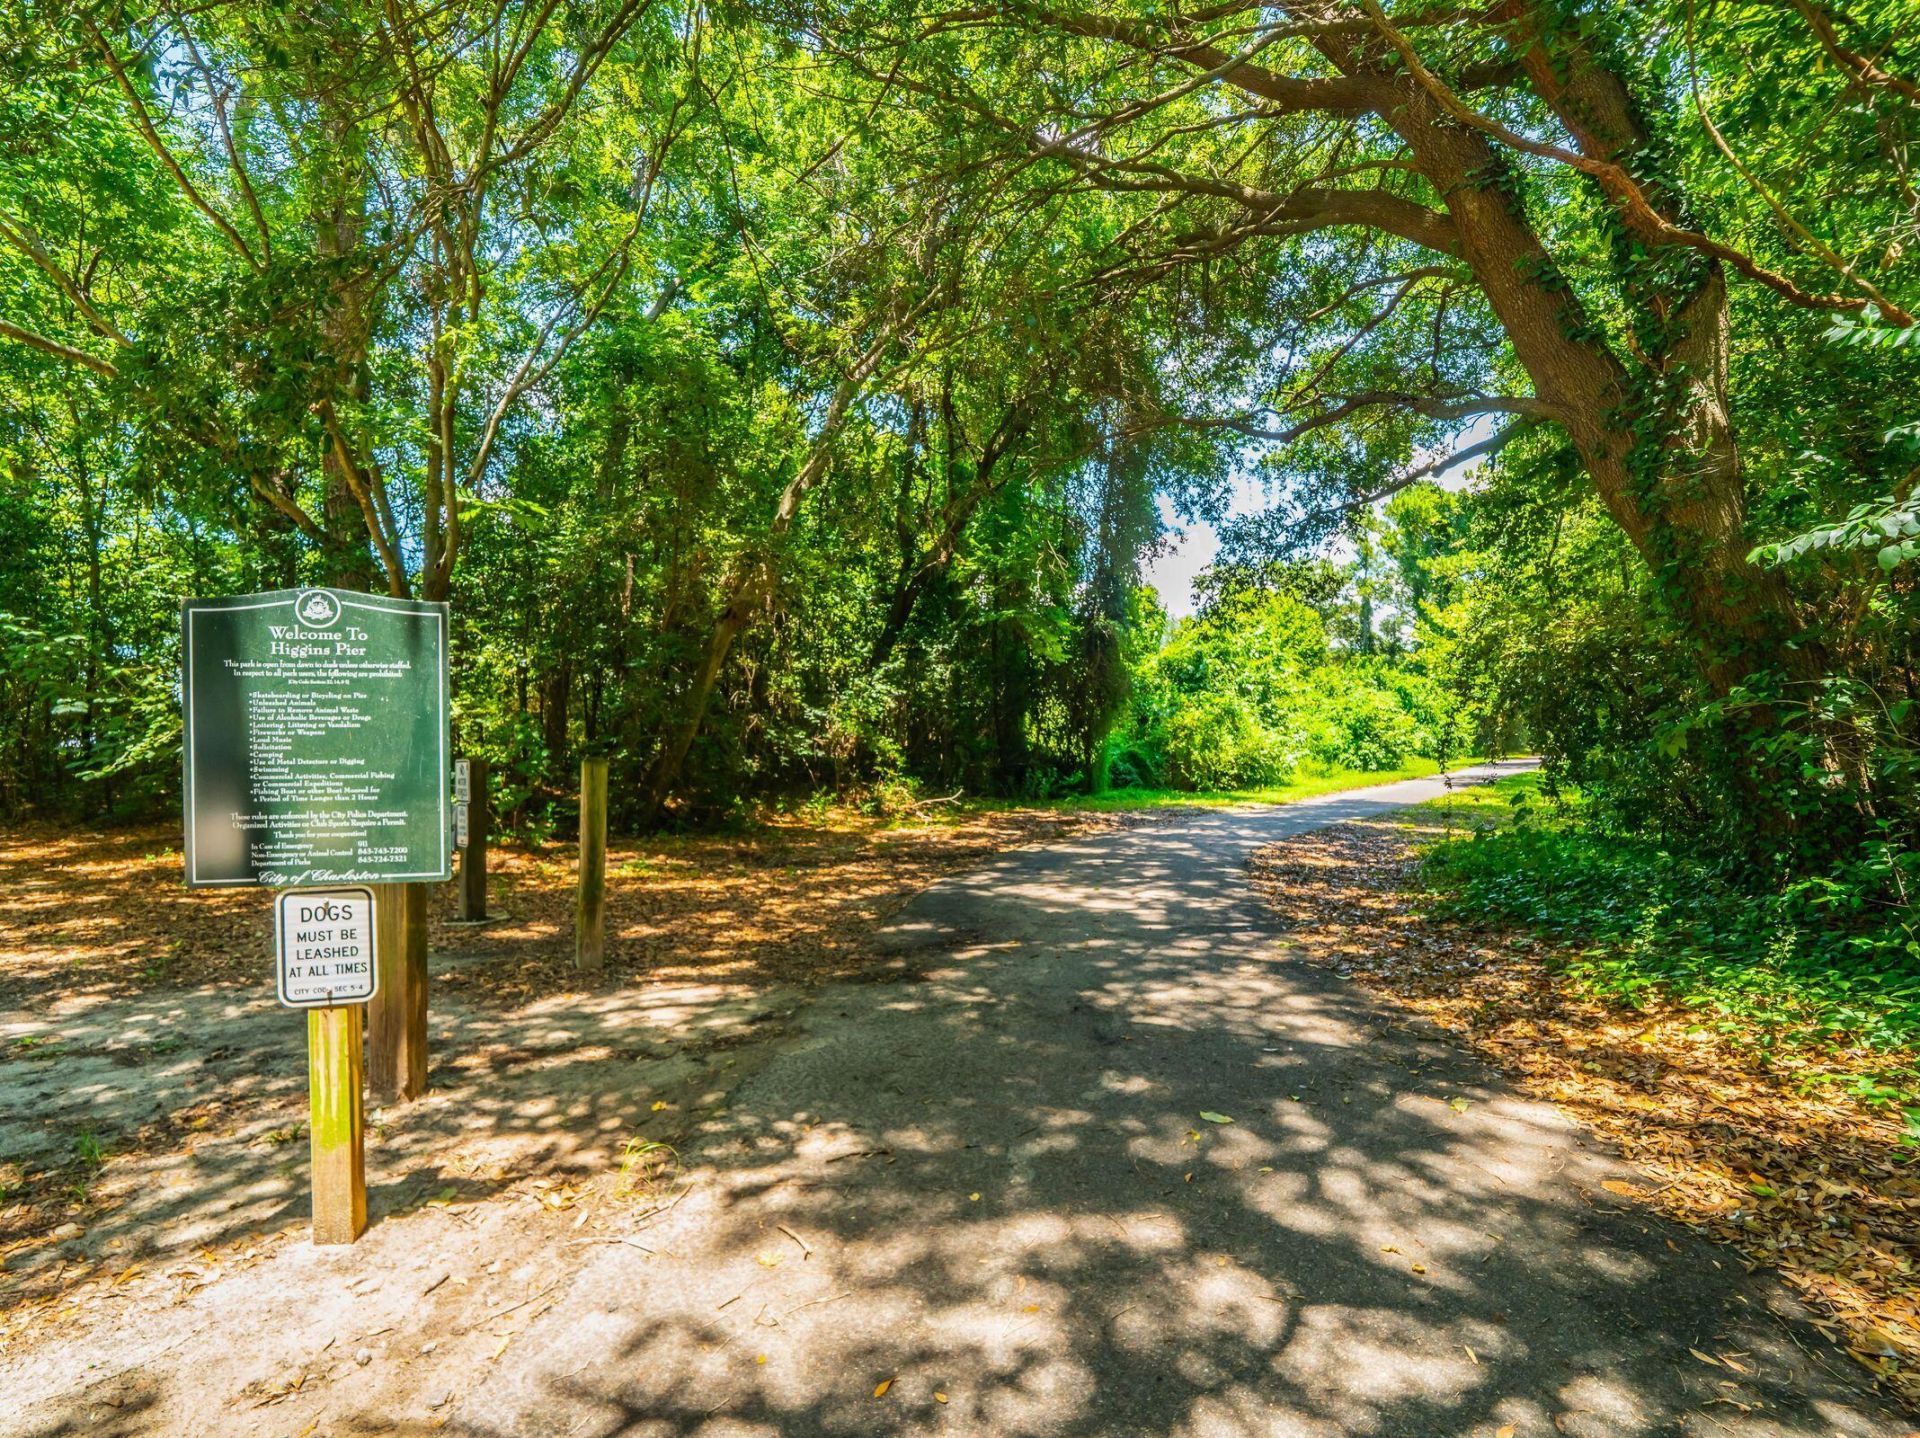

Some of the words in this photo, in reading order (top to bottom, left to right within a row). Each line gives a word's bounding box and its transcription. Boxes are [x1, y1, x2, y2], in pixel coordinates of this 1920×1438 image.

[269, 625, 342, 641] Welcome
[346, 627, 368, 641] To
[271, 642, 330, 658] Higgins
[335, 643, 366, 656] Pier
[253, 691, 300, 699] Skateboarding
[370, 771, 395, 779] Fishing
[304, 780, 343, 788] Expeditions
[231, 812, 250, 820] These
[280, 811, 309, 819] enforced
[331, 811, 345, 819] City
[347, 810, 367, 818] Police
[368, 810, 408, 819] Department.
[232, 820, 268, 829] Organized
[269, 820, 300, 828] Activities
[310, 819, 327, 827] Club
[328, 819, 349, 828] Sports
[351, 819, 376, 828] Require
[383, 818, 406, 826] Permit.
[273, 830, 294, 838] Thank
[259, 842, 273, 850] Case
[281, 842, 314, 850] Emergency
[330, 848, 353, 856] Control
[258, 870, 288, 884] City
[290, 870, 311, 885] of
[311, 869, 379, 882] Charleston
[301, 905, 353, 922] DOGS
[297, 930, 333, 942] MUST
[341, 929, 357, 940] BE
[296, 946, 359, 960] LEASHED
[289, 967, 302, 978] AT
[309, 965, 329, 976] ALL
[335, 962, 368, 974] TIMES
[313, 986, 328, 994] COD
